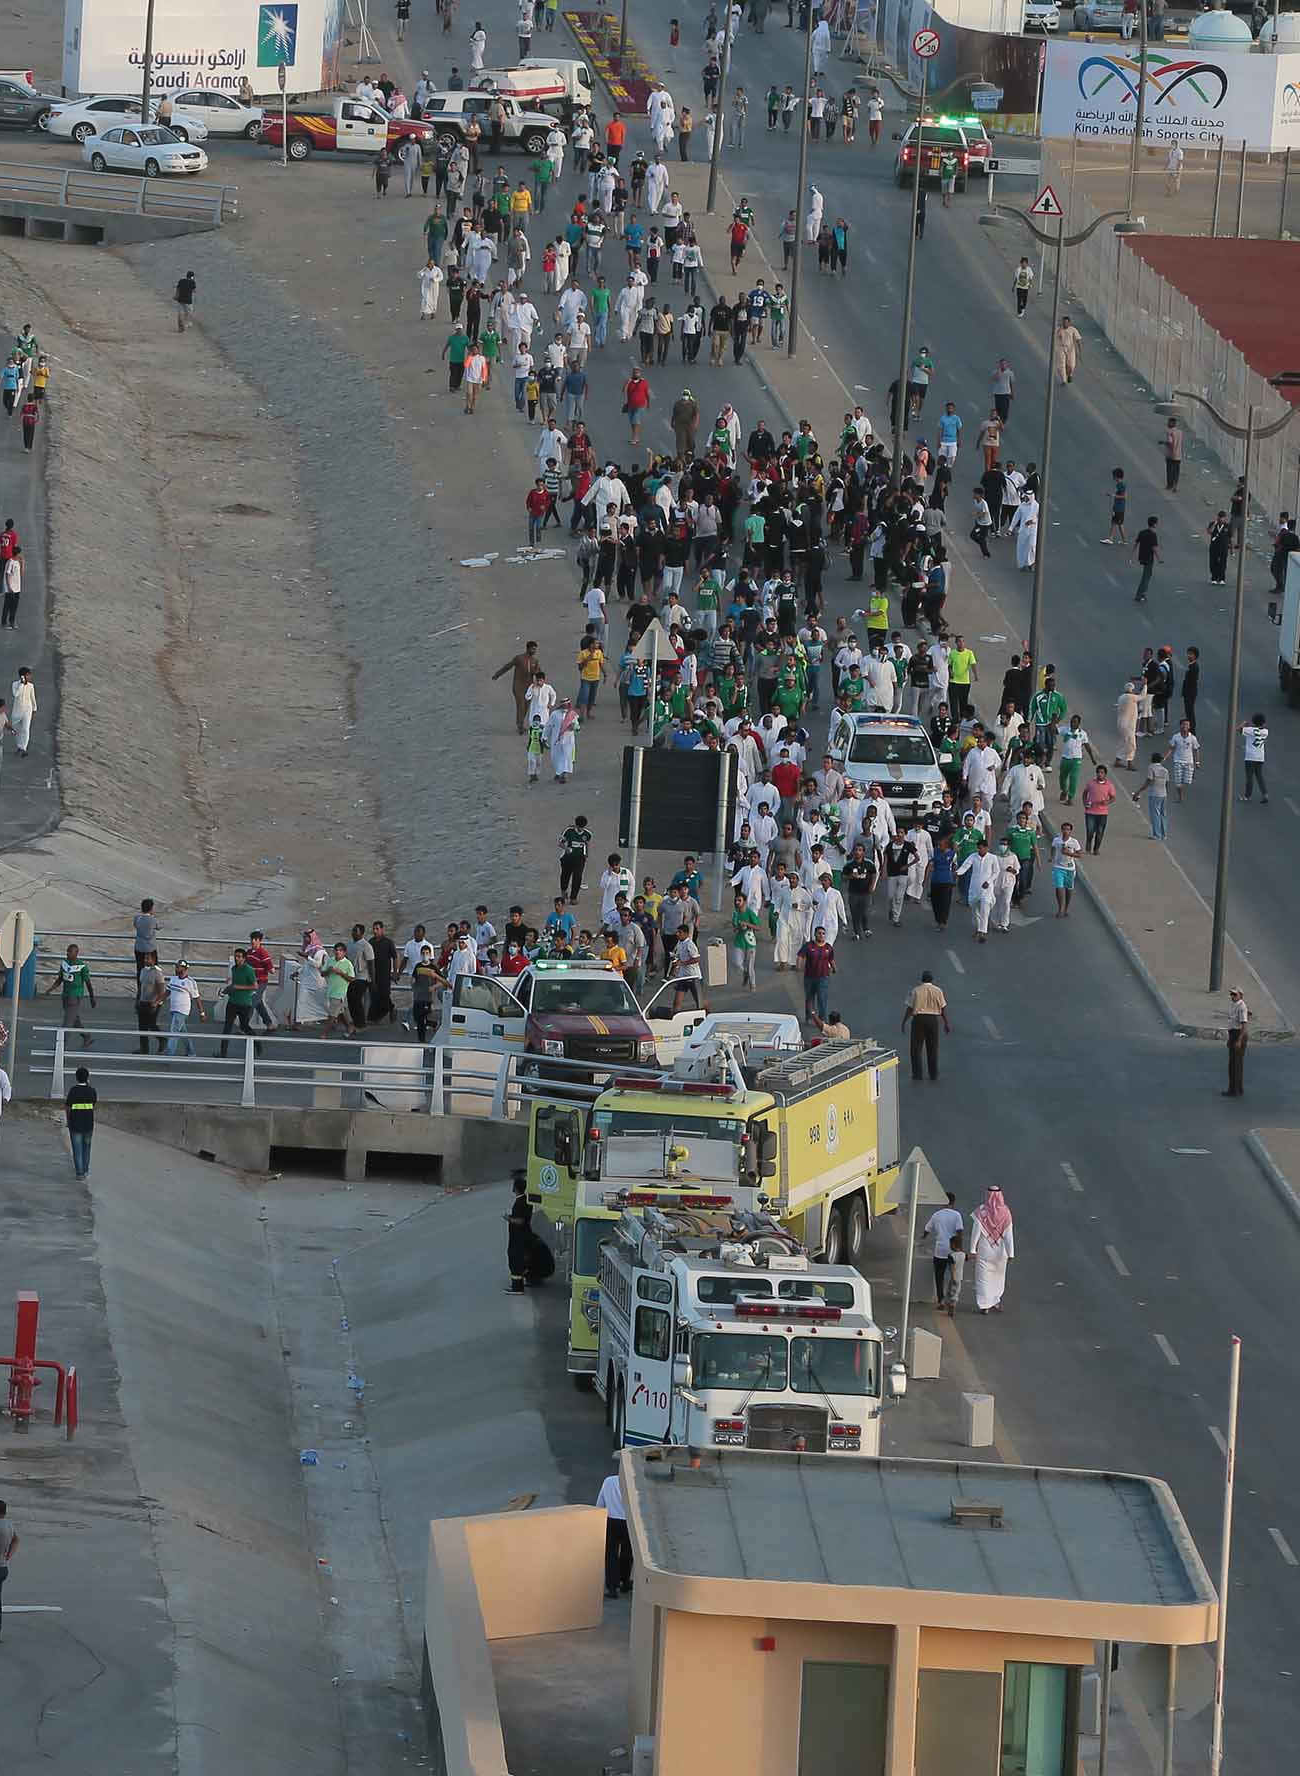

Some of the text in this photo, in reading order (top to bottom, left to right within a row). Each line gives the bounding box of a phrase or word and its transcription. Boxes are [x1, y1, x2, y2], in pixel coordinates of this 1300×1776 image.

[147, 71, 249, 88] Saudi Aramco
[1118, 109, 1151, 124] عالله
[1155, 114, 1188, 126] الملك
[1075, 122, 1224, 144] King Abdulah Sports City
[809, 1124, 820, 1144] 998
[643, 1389, 668, 1410] 110
